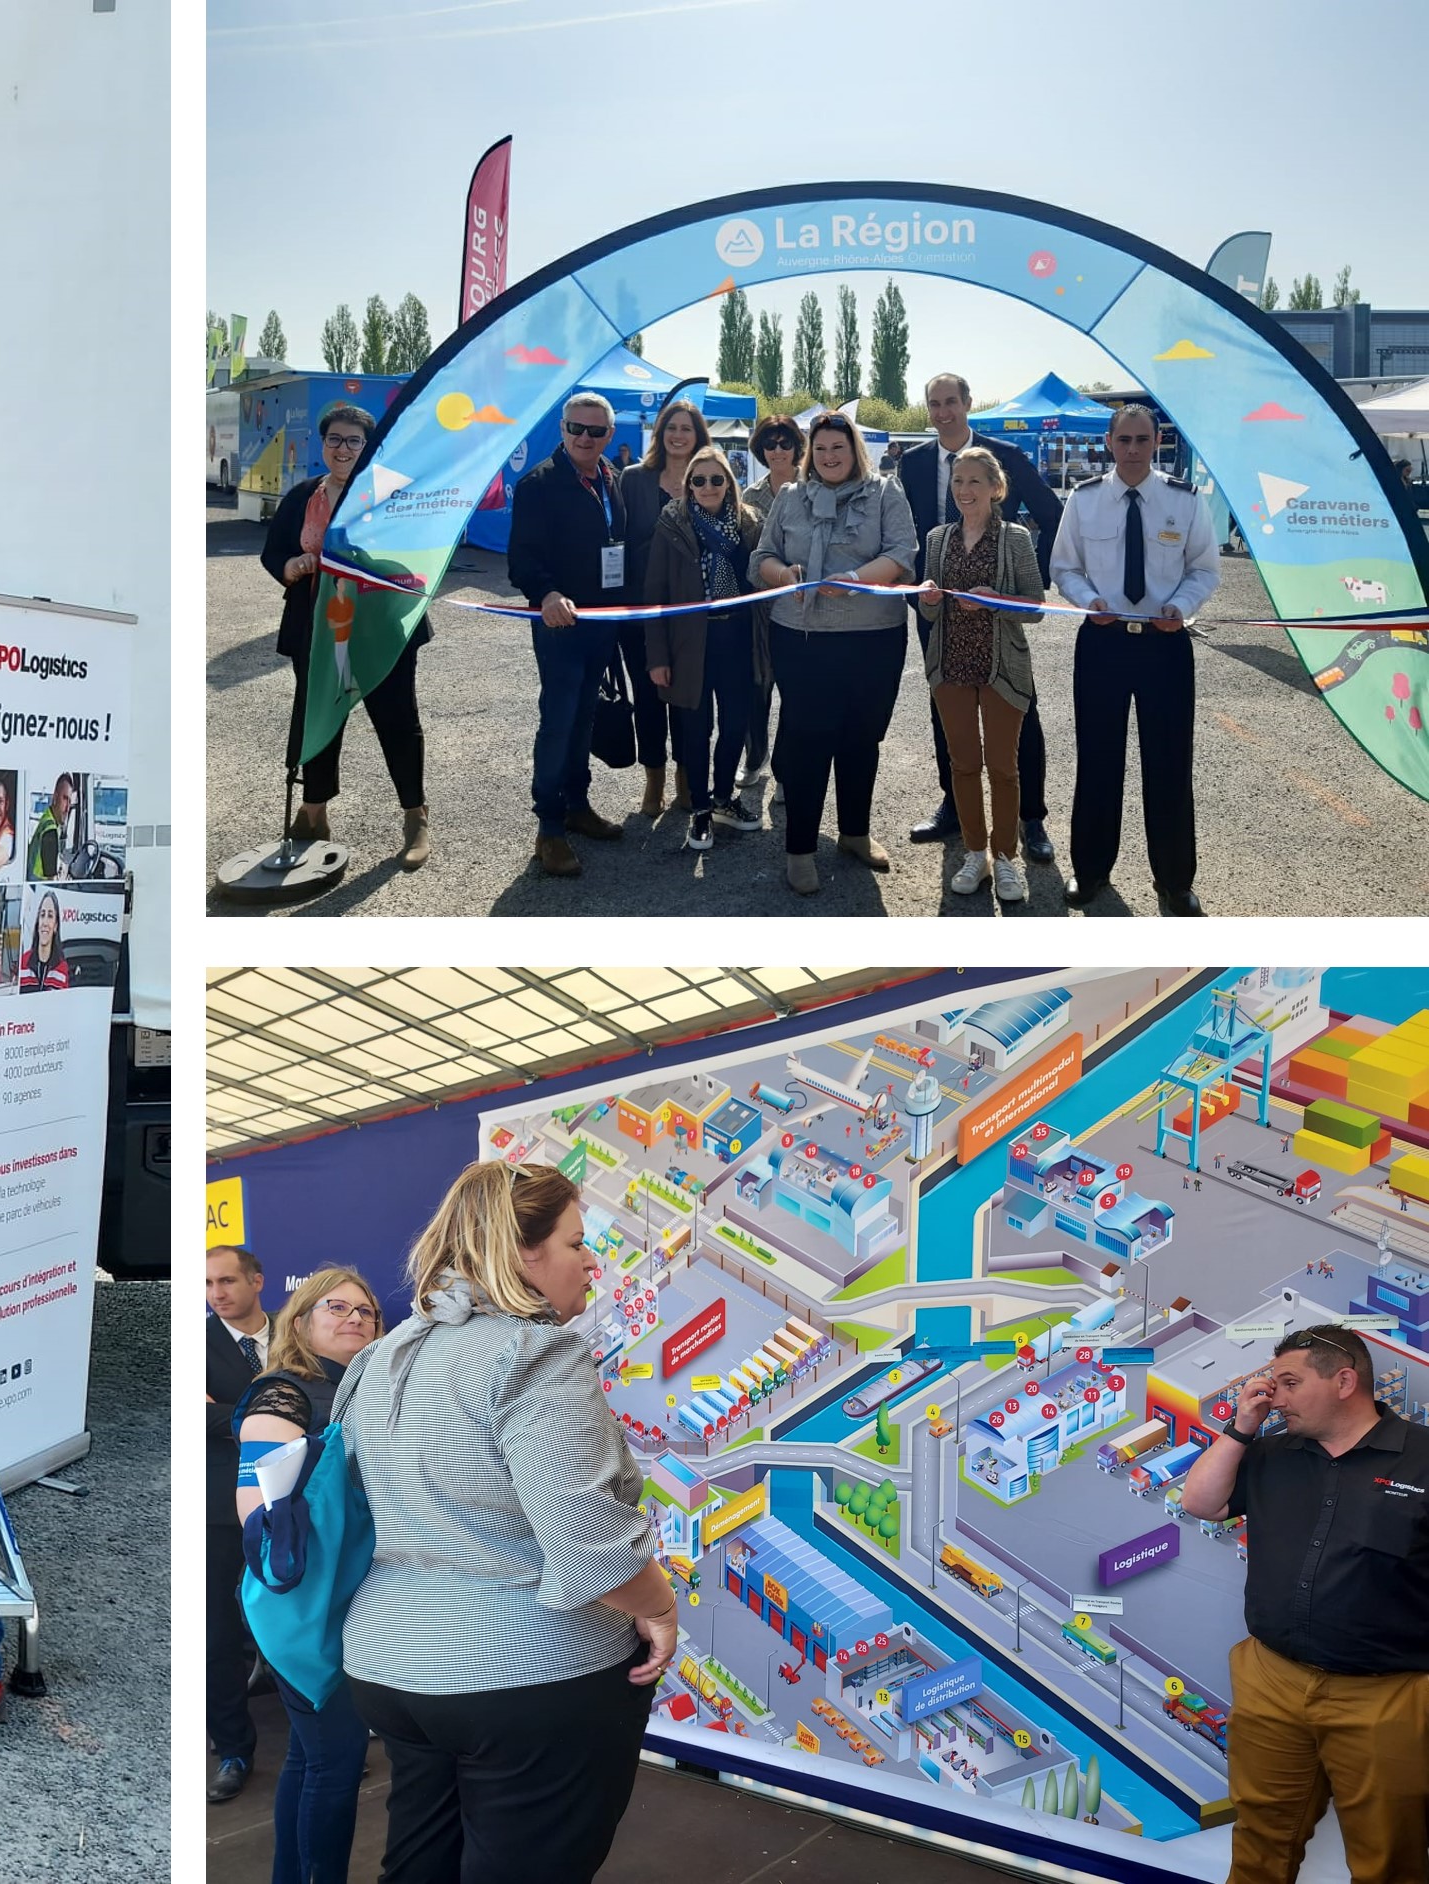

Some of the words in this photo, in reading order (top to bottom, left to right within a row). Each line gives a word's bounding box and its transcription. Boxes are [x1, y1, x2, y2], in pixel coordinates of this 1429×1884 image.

[775, 217, 819, 249] La
[831, 211, 976, 253] Région
[469, 205, 487, 318] OURG
[777, 252, 904, 268] Auvergne-Rhône-Alpes
[908, 251, 976, 265] Orientation
[385, 502, 412, 514] des
[415, 499, 473, 510] métiers
[390, 487, 460, 501] Caravane
[1285, 497, 1371, 512] Caravane
[1286, 512, 1318, 525] des
[1322, 513, 1390, 529] métiers
[105, 713, 112, 741] !
[62, 909, 118, 924] XPOLogistics
[7, 1022, 35, 1036] France
[4, 1046, 24, 1060] 8000
[3, 1065, 23, 1080] 4000
[23, 1061, 63, 1077] conducteurs
[971, 1095, 1017, 1139] Transport
[1017, 1051, 1075, 1104] multimodal
[984, 1124, 996, 1138] et
[995, 1077, 1059, 1132] international
[12, 1151, 58, 1173] investissons
[59, 1147, 78, 1160] dans
[206, 1201, 229, 1231] AC
[22, 1264, 67, 1288] d'intégration
[67, 1260, 77, 1272] et
[22, 1282, 78, 1315] professionnelle
[671, 1330, 701, 1356] Transport
[700, 1312, 722, 1332] routier
[671, 1355, 679, 1366] de
[679, 1323, 722, 1359] marchandises
[1373, 1477, 1425, 1493] XPOLogistics
[710, 1497, 761, 1533] Déménagement
[1113, 1538, 1169, 1573] Logistique
[767, 1580, 781, 1596] BOX
[914, 1701, 926, 1711] de
[927, 1681, 976, 1708] distribution
[922, 1673, 965, 1698] Logistique
[798, 1736, 816, 1750] MARKET
[800, 1730, 814, 1743] SUPER
